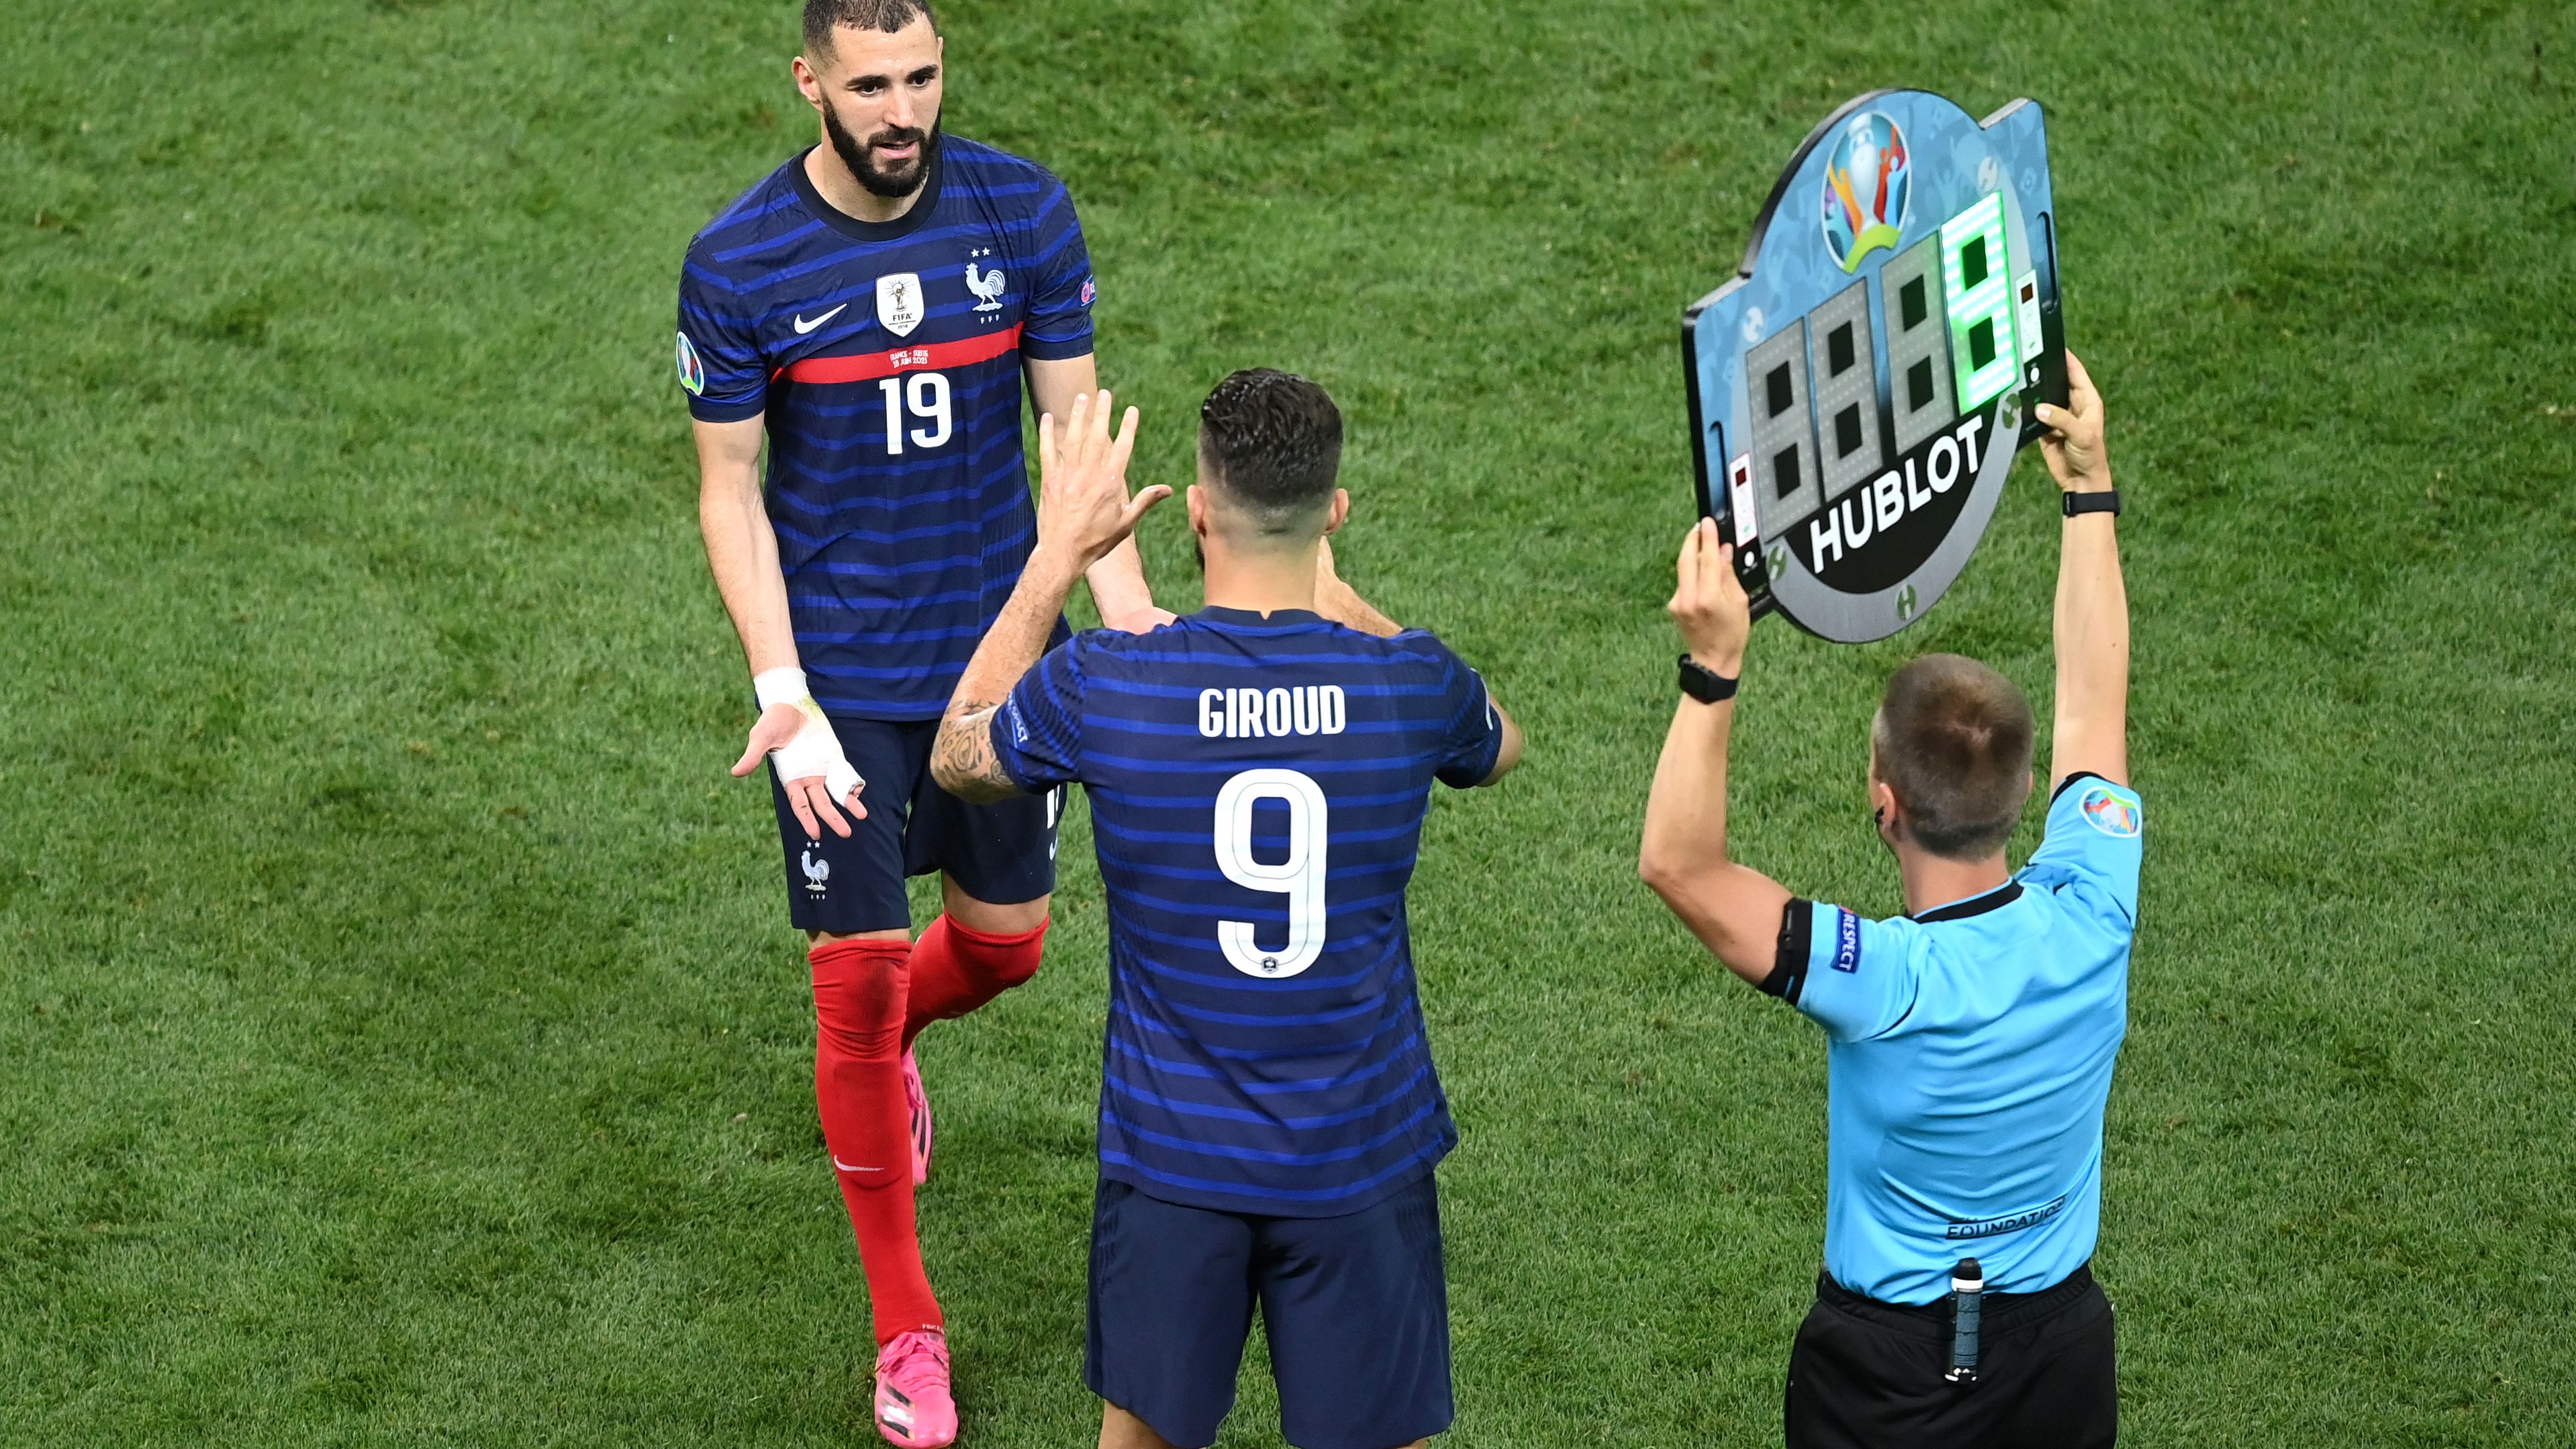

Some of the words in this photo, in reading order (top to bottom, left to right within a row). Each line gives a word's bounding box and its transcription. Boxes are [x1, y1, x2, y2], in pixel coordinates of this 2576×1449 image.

[893, 313, 911, 321] FIFA
[1942, 191, 2018, 414] 9
[890, 350, 908, 361] FRANCE
[900, 357, 912, 366] JUIN
[912, 357, 928, 365] 2021
[879, 373, 952, 455] 19
[1809, 414, 1983, 575] HUBLOT
[1198, 685, 1346, 738] GIROUD
[1214, 768, 1328, 978] 9
[1839, 913, 1856, 971] RESPECT
